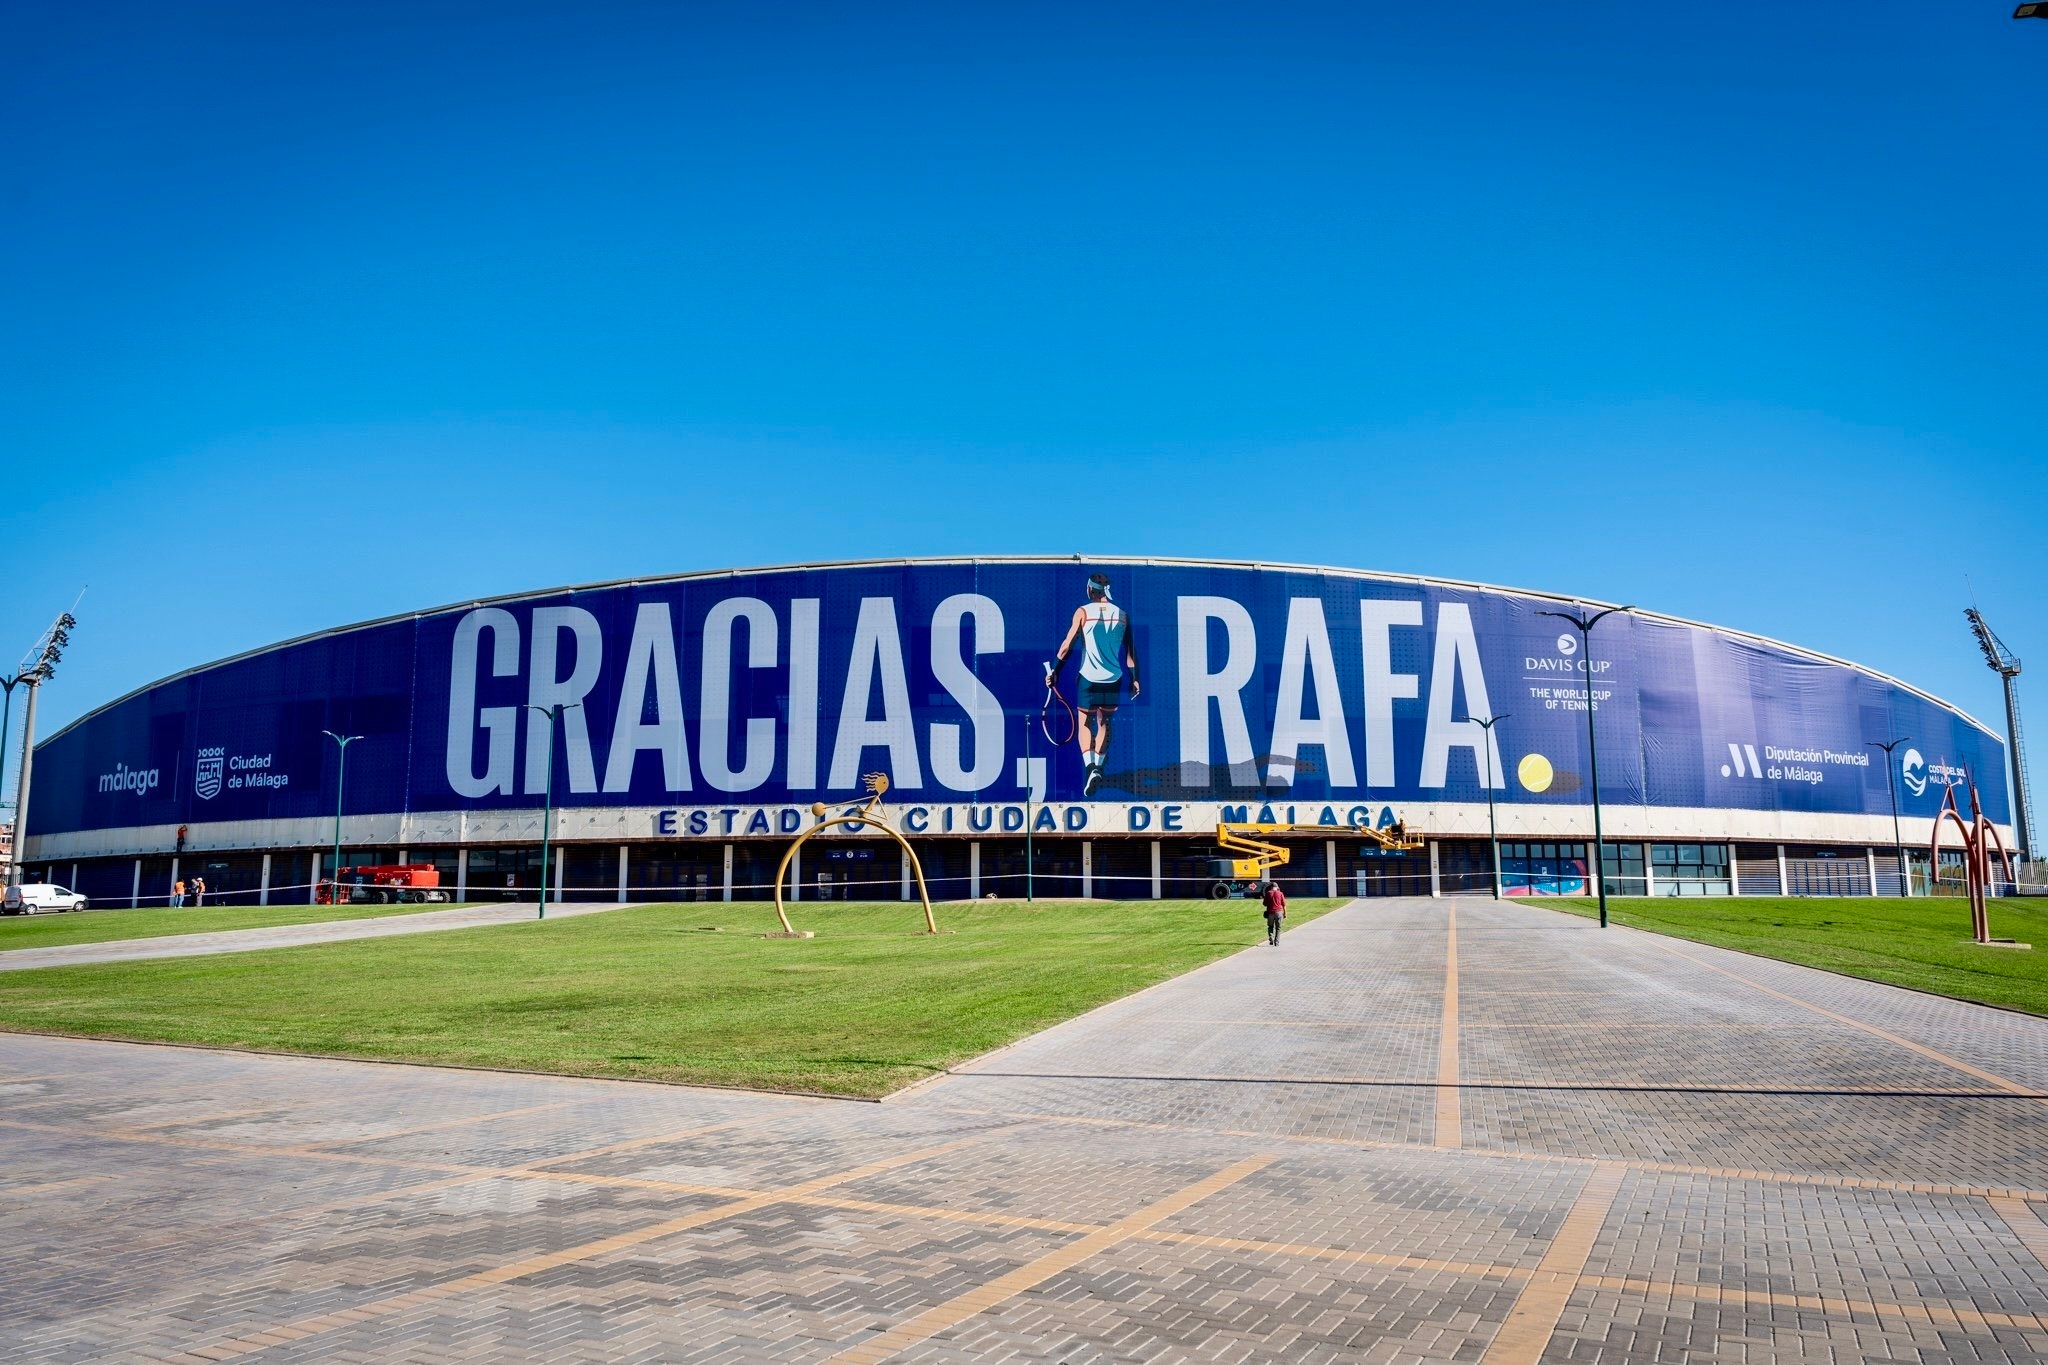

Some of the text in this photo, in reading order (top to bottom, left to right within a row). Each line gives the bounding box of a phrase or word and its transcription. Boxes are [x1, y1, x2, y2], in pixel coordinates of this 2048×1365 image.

[1525, 657, 1573, 672] DAVIS
[446, 593, 1506, 803] GRACIAS, RAFA
[1530, 687, 1611, 700] THE WORLD CUP
[1545, 699, 1598, 711] OF TENNS
[229, 753, 272, 770] Ciudad
[1765, 745, 1869, 766] Diputación Provincial
[1767, 766, 1823, 785] de Málaga
[1928, 764, 1946, 775] COST
[1956, 767, 1967, 777] SOL
[227, 772, 289, 789] de Málaga
[907, 805, 1088, 832] CIUDAD
[1130, 805, 1184, 831] DE
